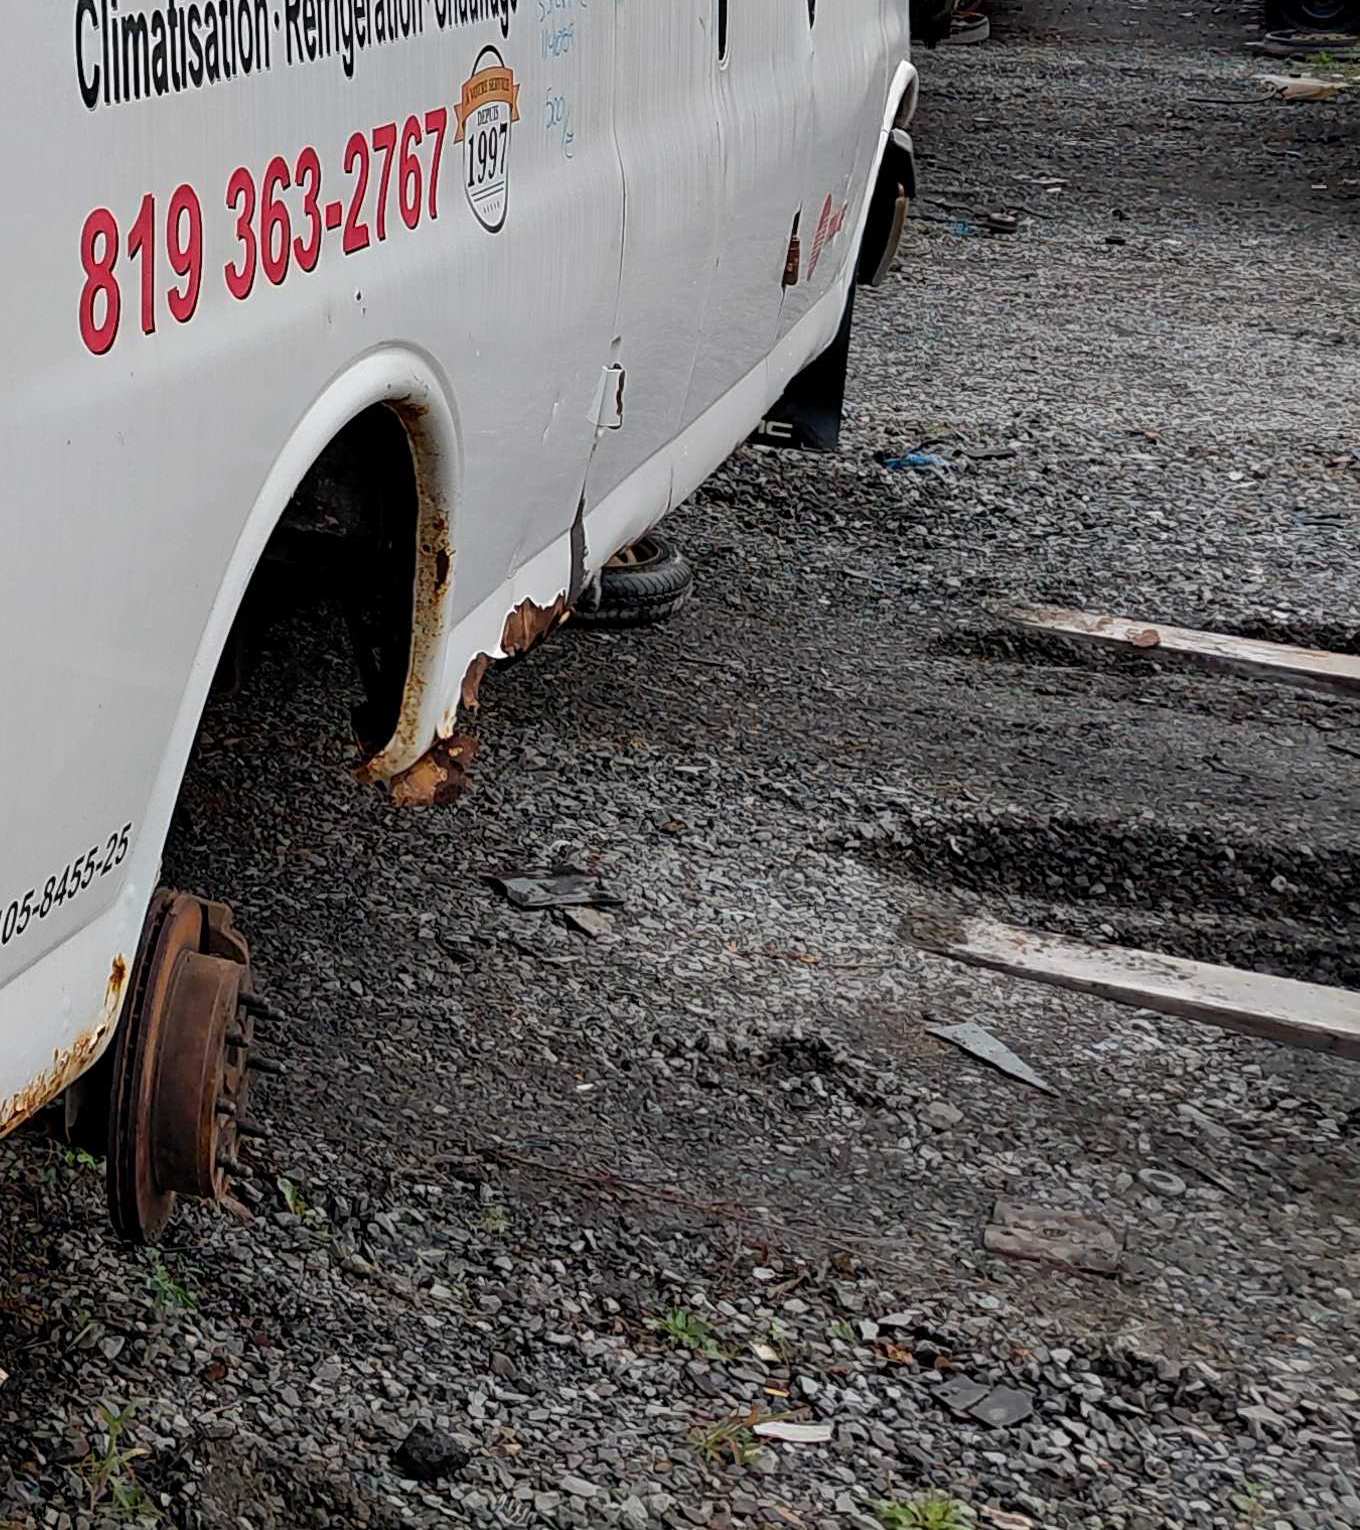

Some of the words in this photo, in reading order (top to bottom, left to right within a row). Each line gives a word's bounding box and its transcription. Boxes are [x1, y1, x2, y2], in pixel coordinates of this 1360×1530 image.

[79, 183, 202, 355] 819
[224, 107, 447, 300] 363-2767
[467, 121, 508, 188] 1997
